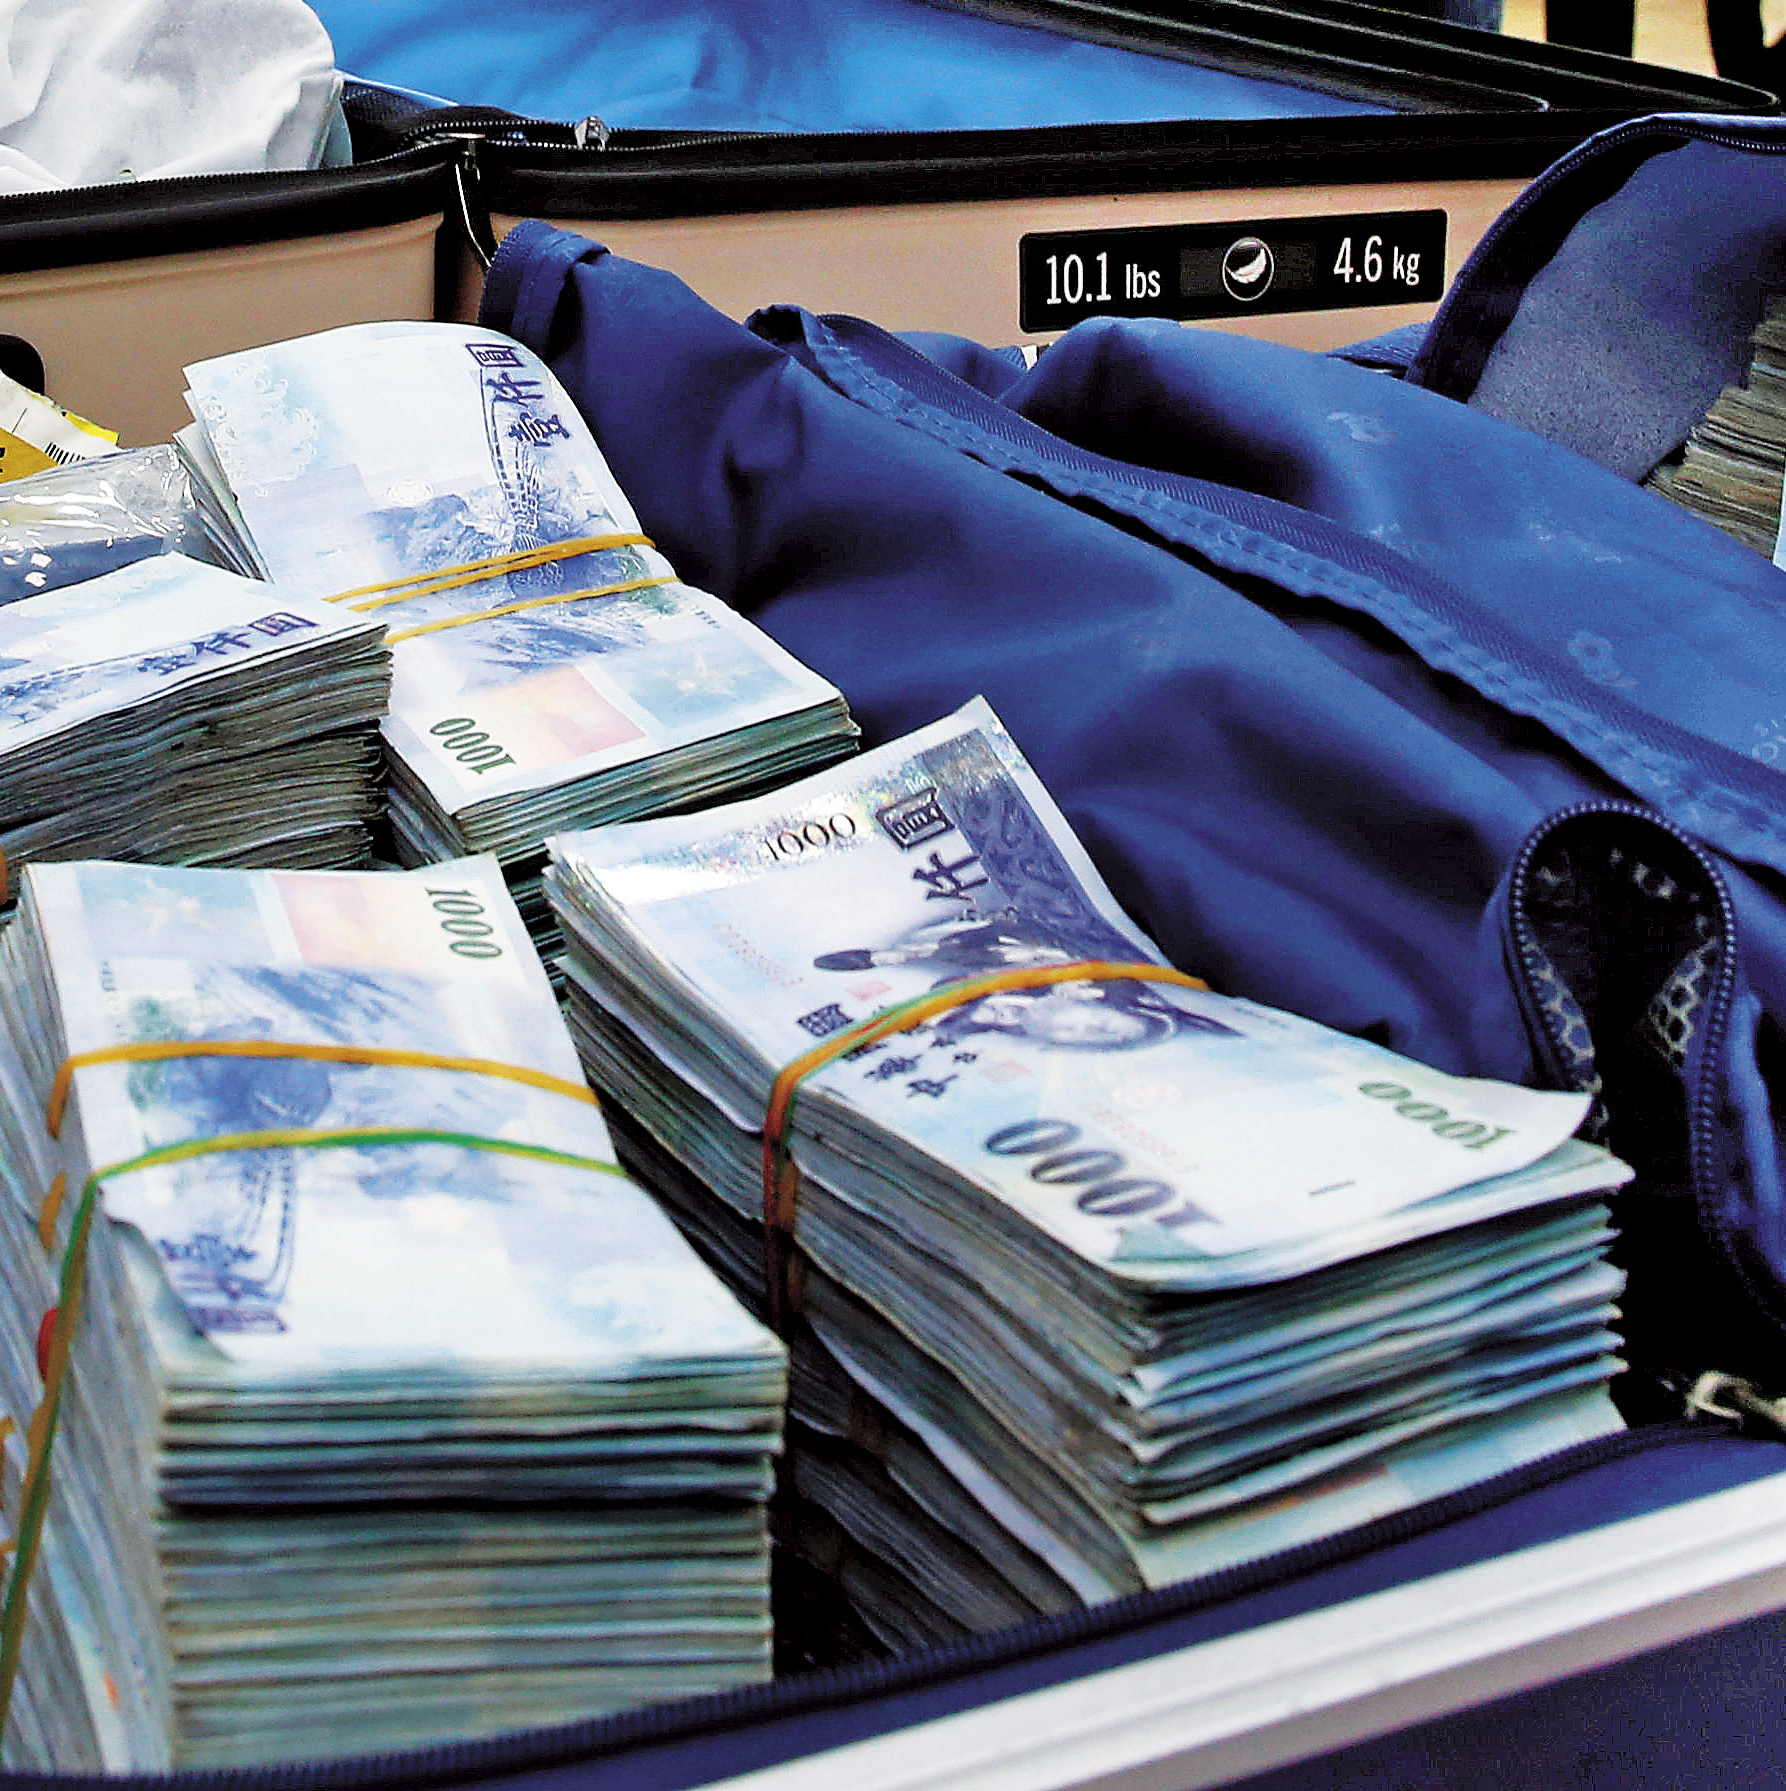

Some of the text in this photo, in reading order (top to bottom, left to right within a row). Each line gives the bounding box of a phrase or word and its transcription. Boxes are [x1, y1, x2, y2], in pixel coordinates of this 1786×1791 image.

[1045, 234, 1421, 305] 10.1 lbs 4.6 kg
[428, 715, 517, 776] 1000
[763, 812, 856, 861] 1000
[425, 886, 503, 960] 1000
[1356, 1079, 1517, 1152] 1000
[983, 1116, 1228, 1234] 1000
